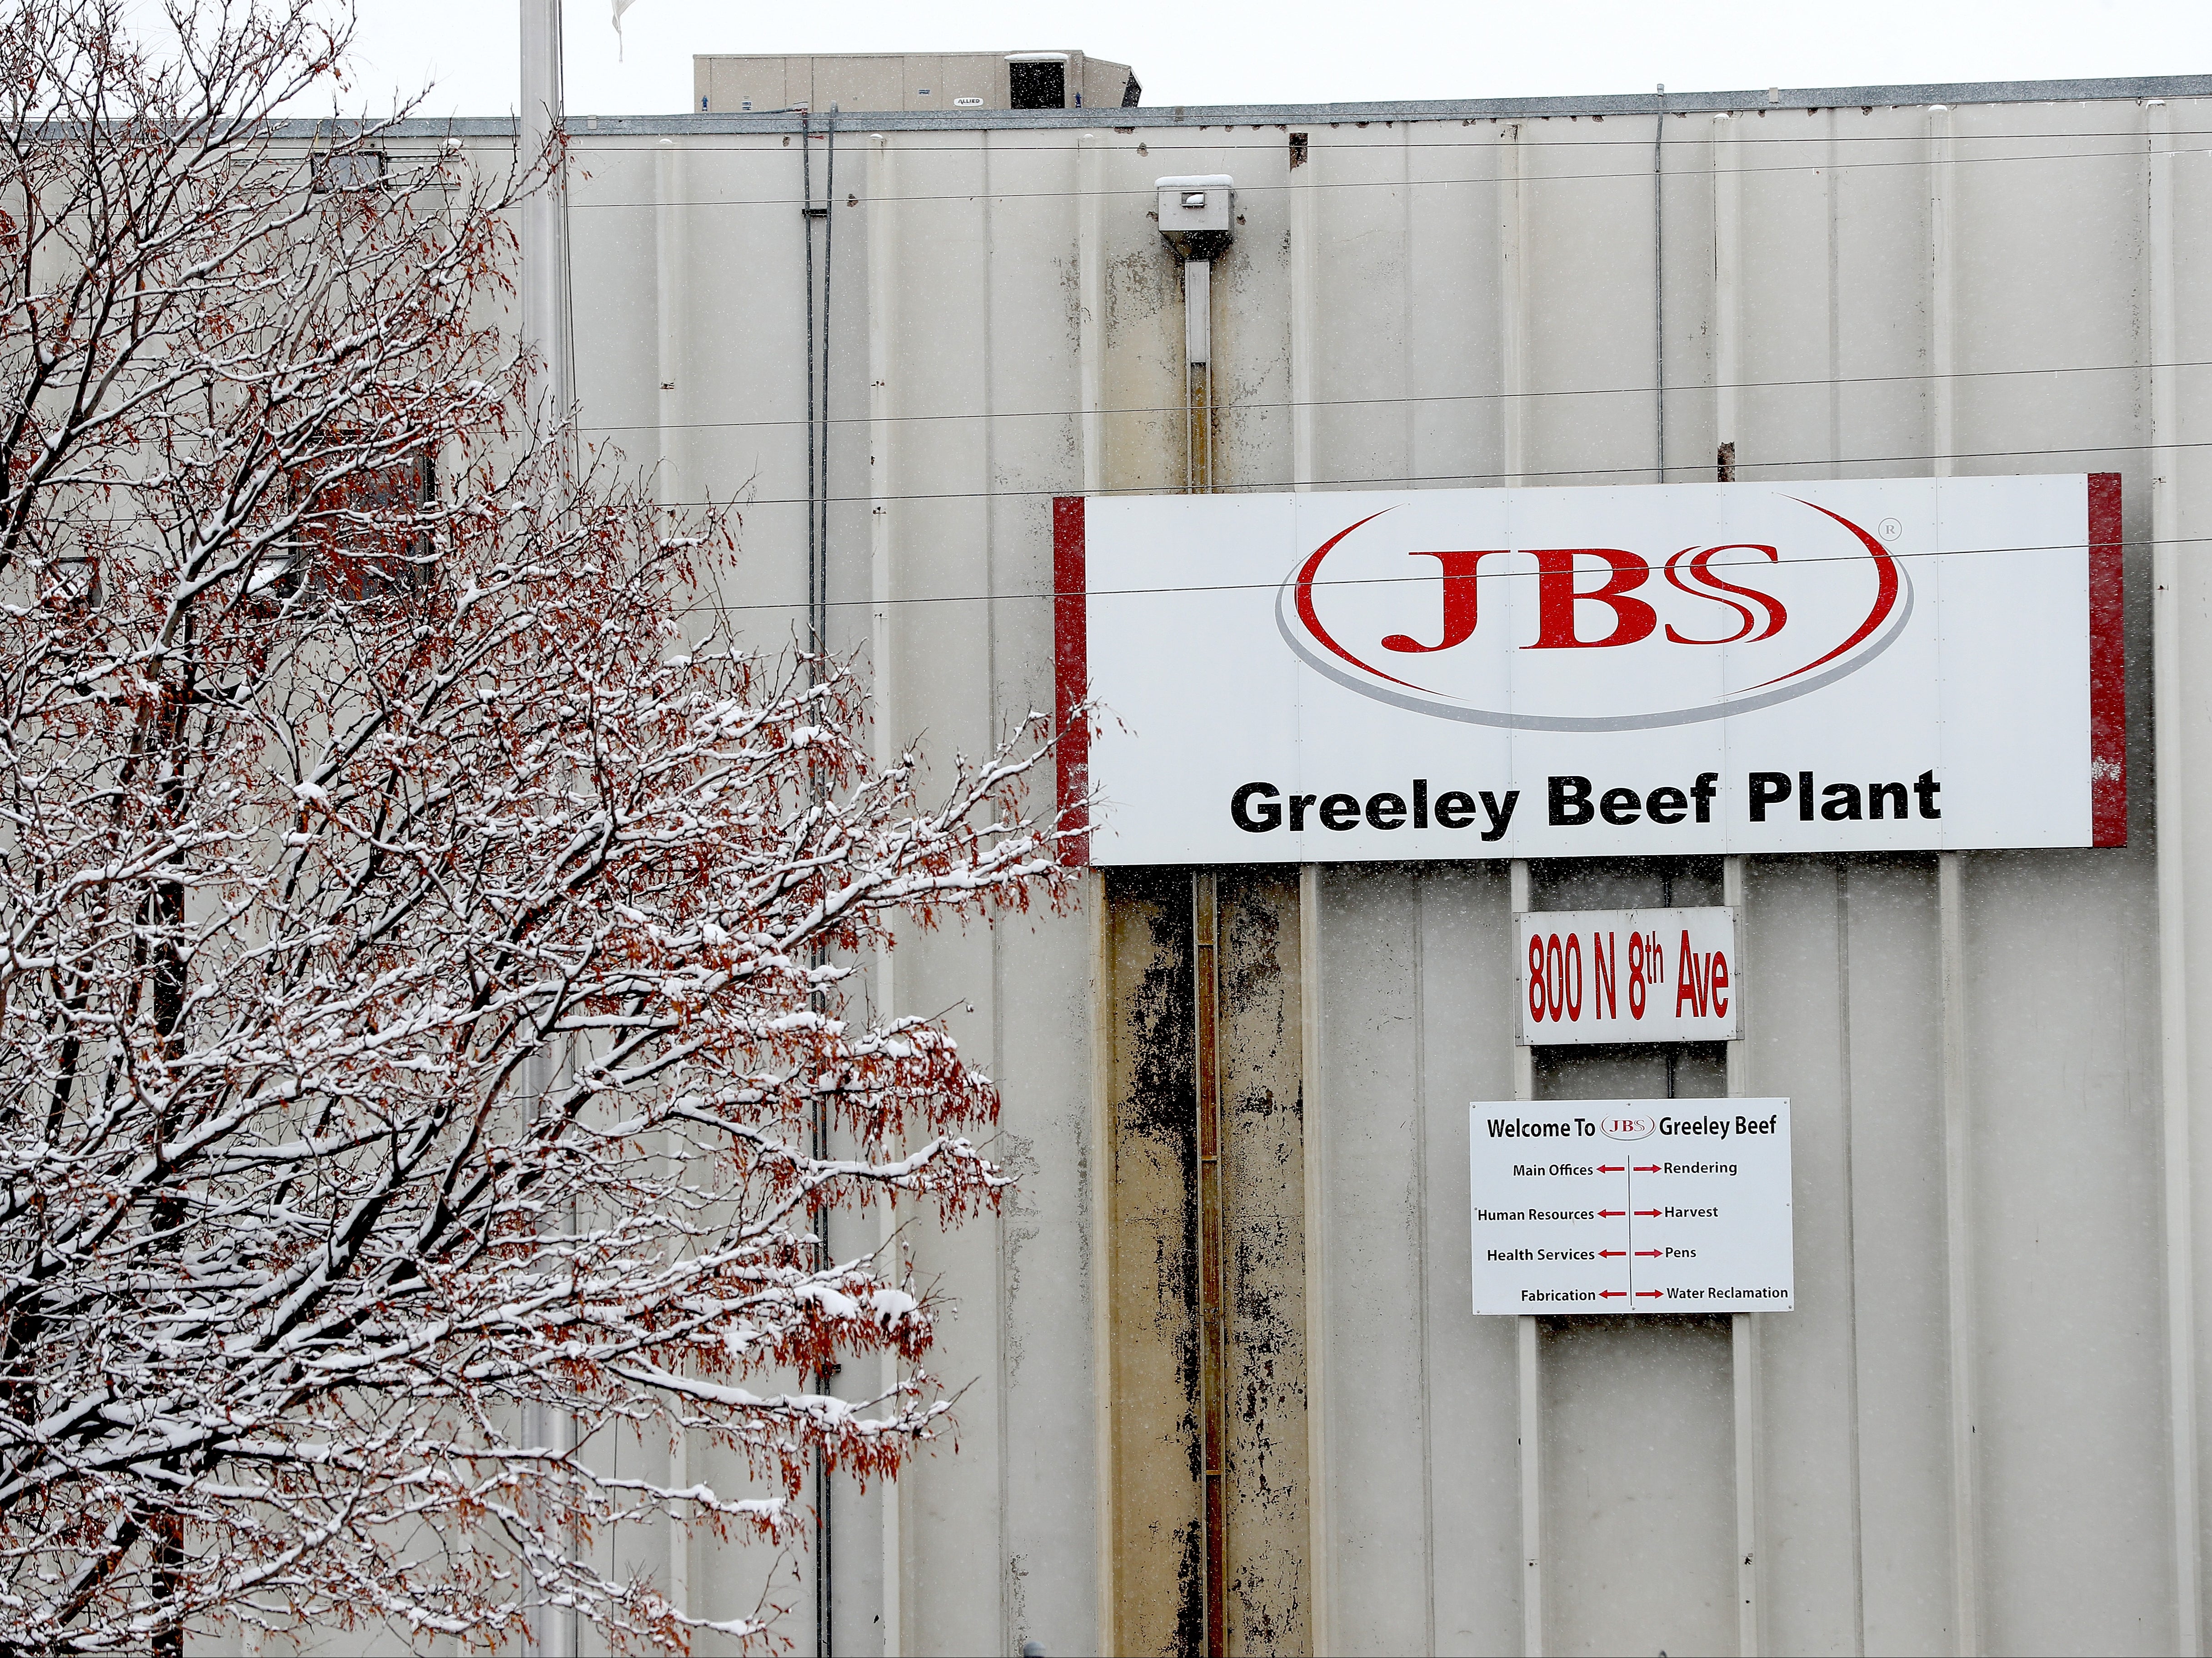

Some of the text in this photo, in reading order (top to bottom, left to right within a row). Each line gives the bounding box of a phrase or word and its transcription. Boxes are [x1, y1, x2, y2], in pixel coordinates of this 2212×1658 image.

[1381, 544, 1788, 653] JBS
[1231, 769, 1942, 842] Greeley Beef Plant
[1528, 930, 1729, 1023] 800 N 8th Ave
[1487, 1114, 1777, 1140] Welcome To JBS Greeley Beef
[1513, 1164, 1593, 1176] Main Offices
[1664, 1161, 1737, 1176] Rendering
[1478, 1209, 1594, 1221] Human Resources
[1665, 1206, 1718, 1218] Harvest
[1488, 1248, 1595, 1261] Health Services
[1665, 1247, 1697, 1258] Pens
[1521, 1289, 1596, 1301] Fabrication
[1666, 1286, 1788, 1299] Water Reclamation
